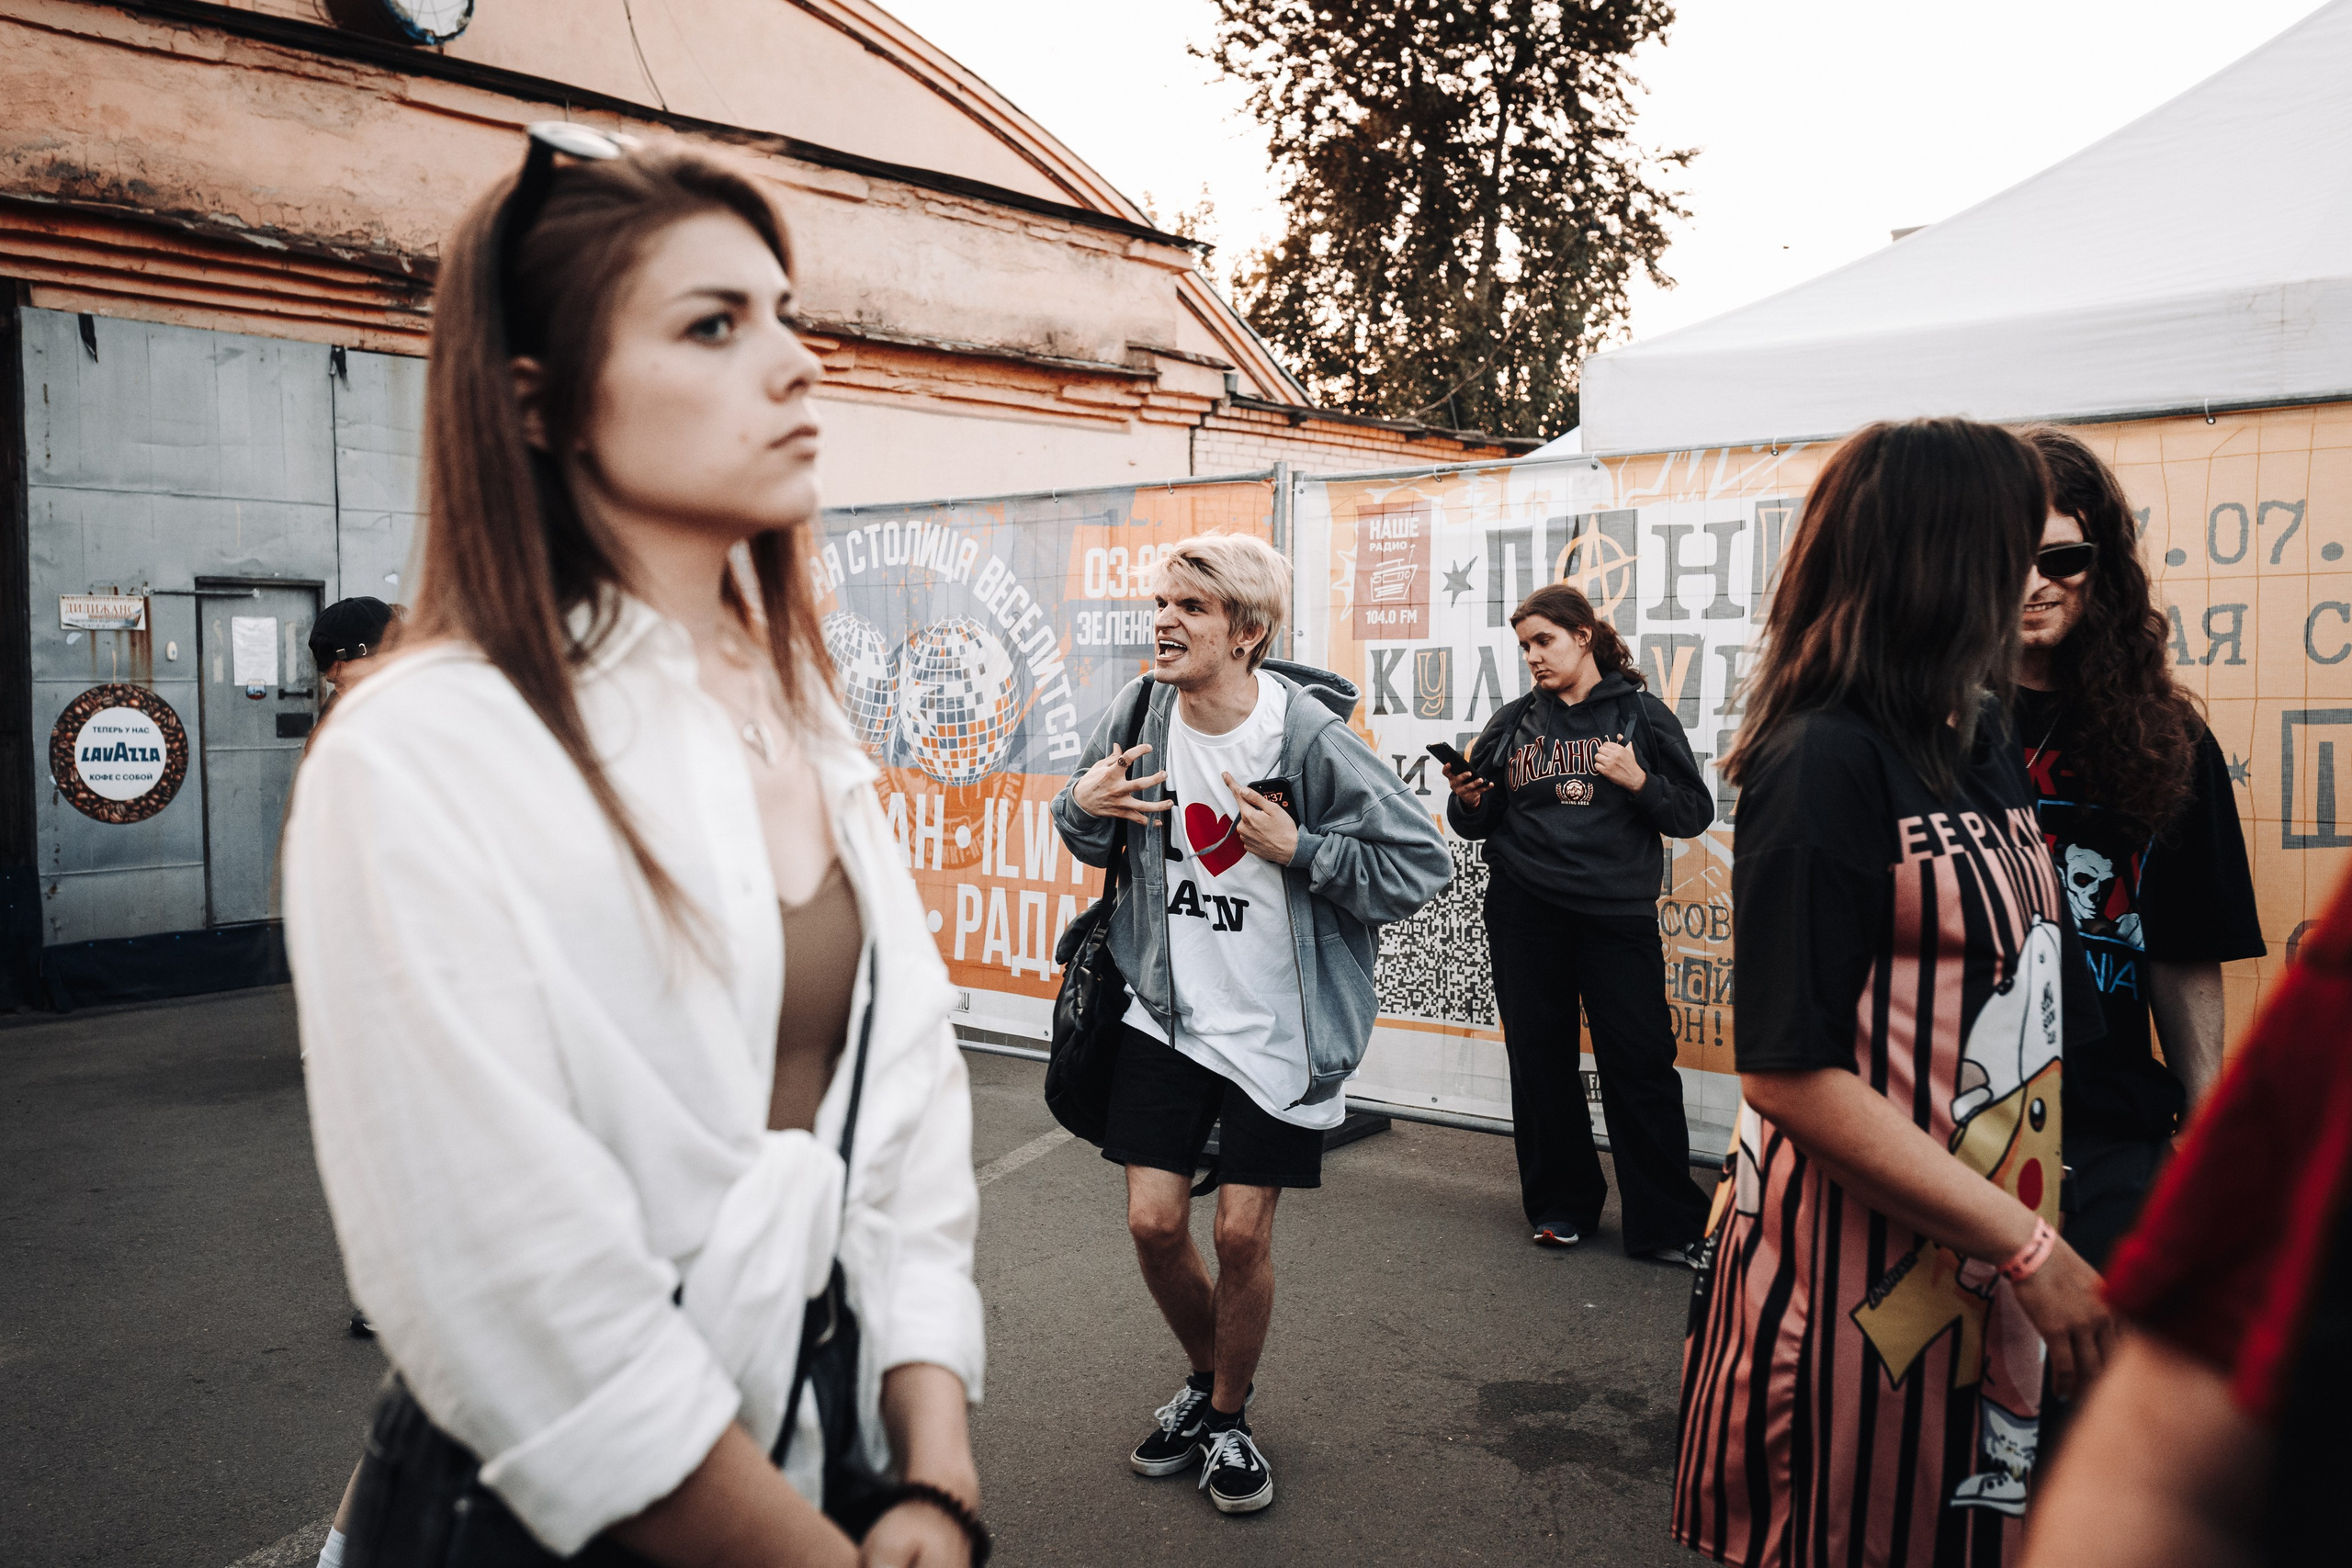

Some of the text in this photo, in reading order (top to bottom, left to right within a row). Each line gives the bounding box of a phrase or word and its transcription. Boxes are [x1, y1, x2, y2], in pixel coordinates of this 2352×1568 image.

[1369, 517, 1419, 540] НАШЕ
[1369, 541, 1408, 552] РАДИО
[1077, 610, 1157, 645] ЗЕЛЕНА
[1365, 609, 1418, 624] 104.0 FM
[846, 520, 979, 586] СТОЛИЦА
[973, 555, 1081, 761] ВЕСЕЛИТСЯ
[81, 741, 161, 762] LAVAZZA
[1509, 735, 1620, 792] OKLAHO
[123, 773, 153, 781] СОБОЙ
[954, 883, 1103, 982] РАДА
